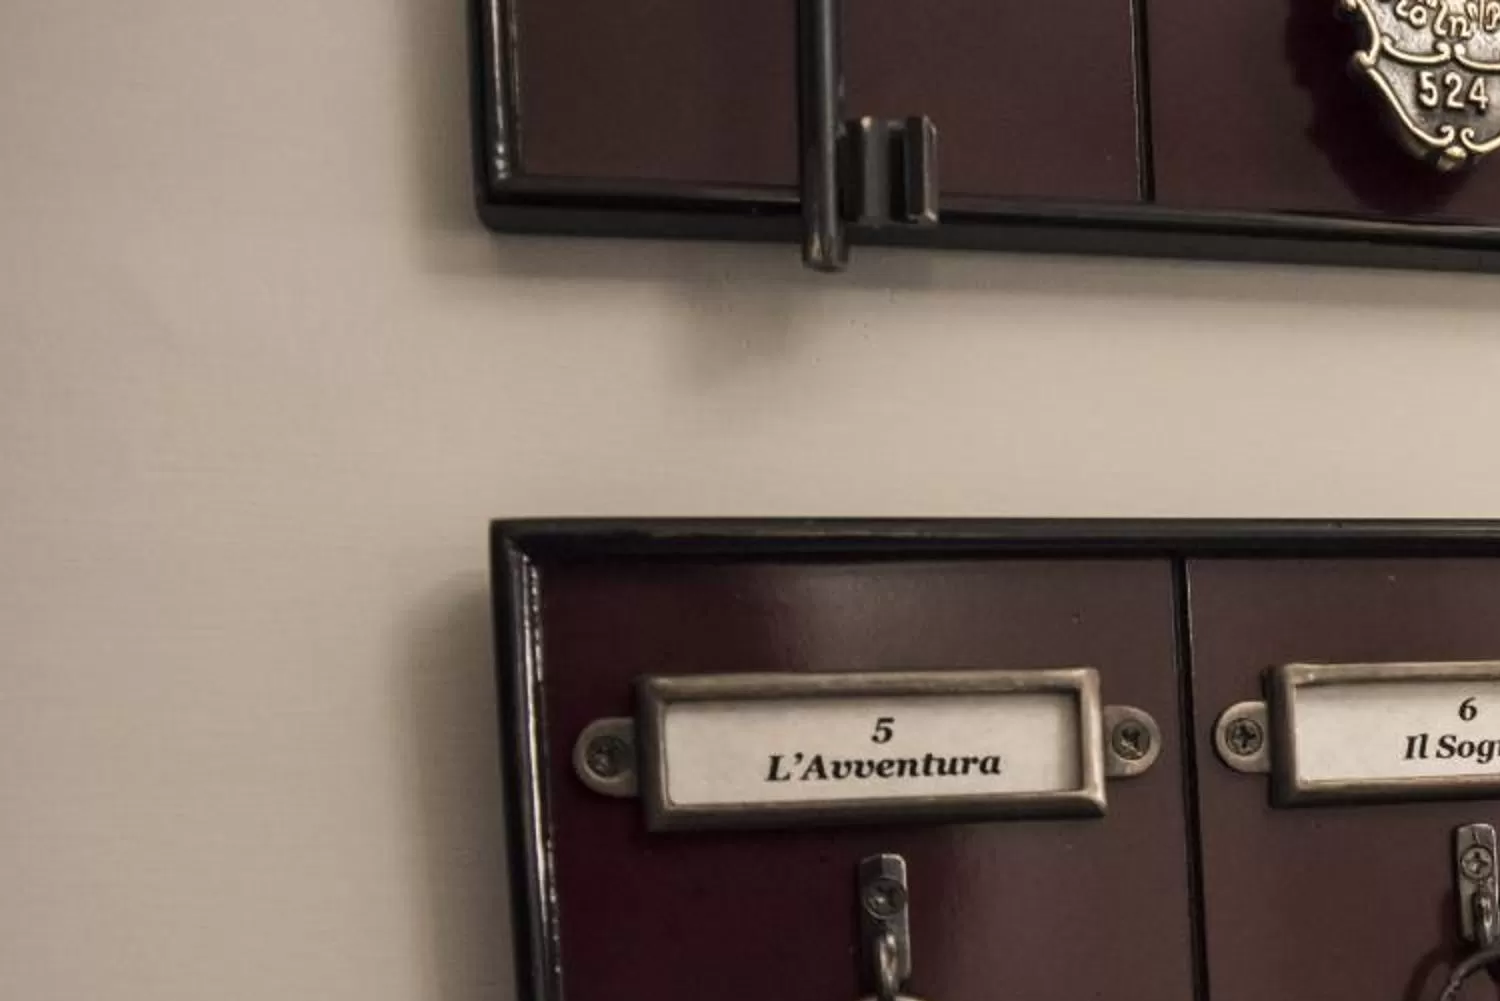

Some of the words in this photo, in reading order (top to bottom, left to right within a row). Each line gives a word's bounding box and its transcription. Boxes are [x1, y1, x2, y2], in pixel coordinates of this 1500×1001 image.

[1417, 70, 1490, 110] 524
[1458, 697, 1478, 722] 6
[870, 717, 896, 744] 5
[1403, 733, 1428, 761] Il
[763, 751, 1002, 783] L'Avventura
